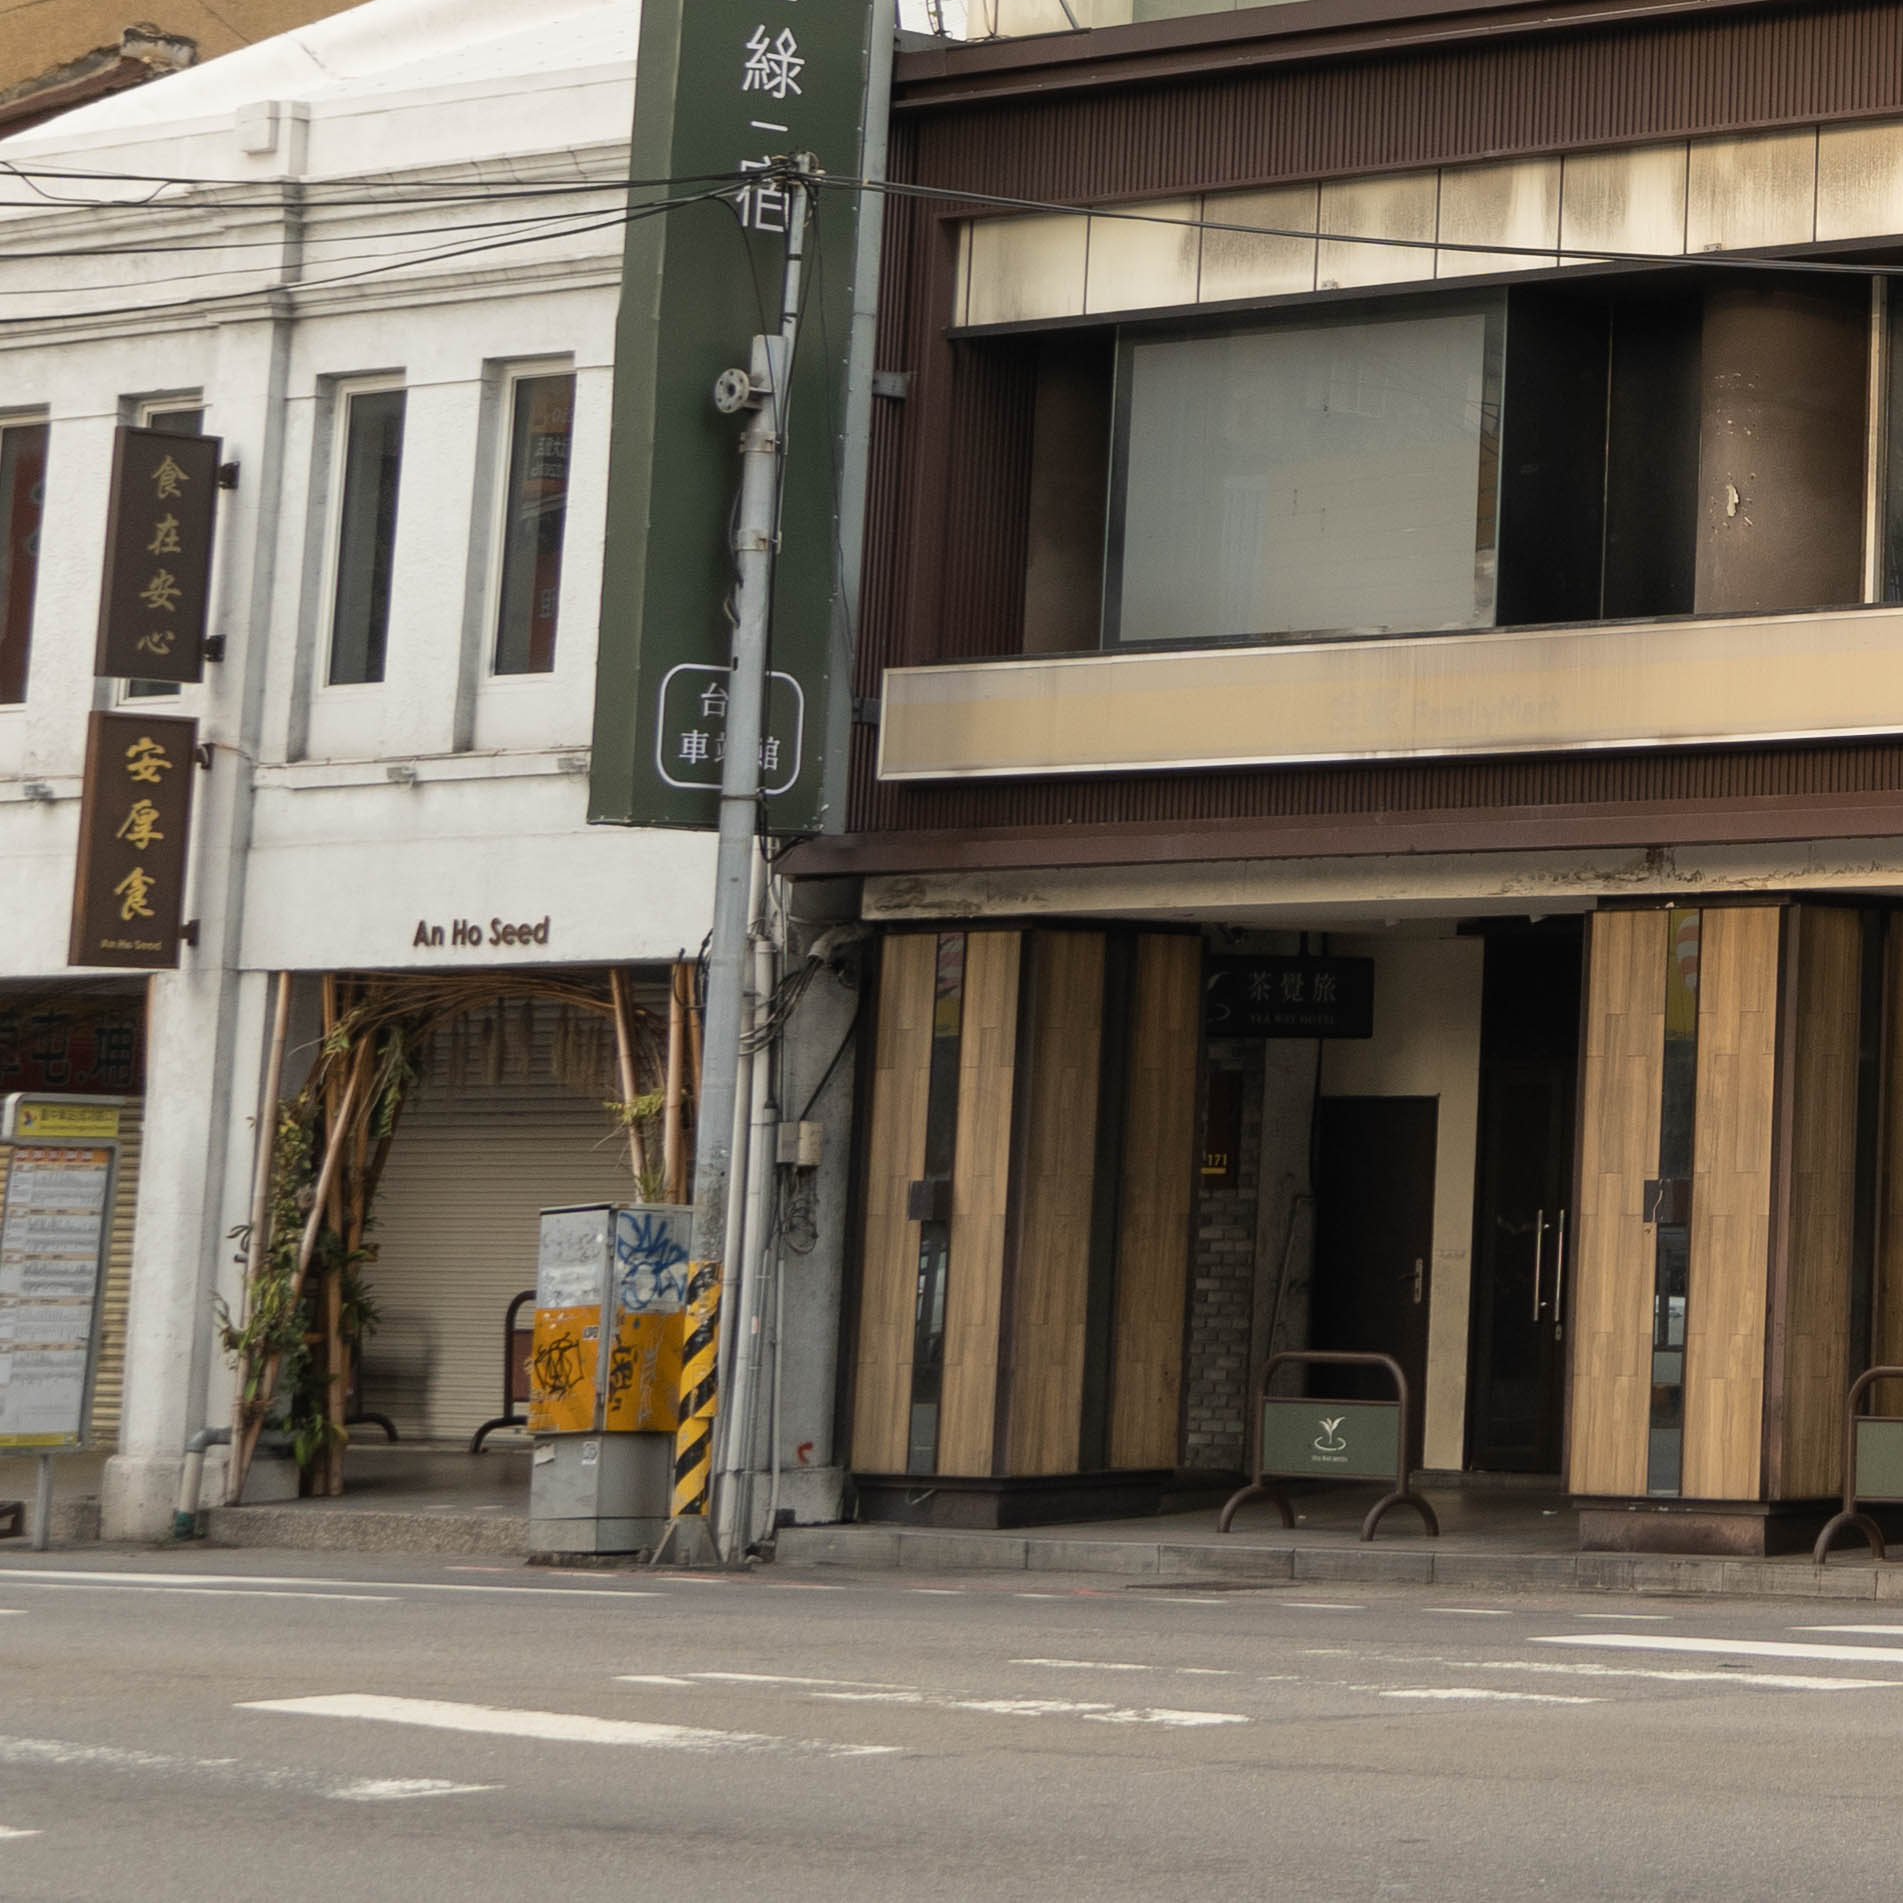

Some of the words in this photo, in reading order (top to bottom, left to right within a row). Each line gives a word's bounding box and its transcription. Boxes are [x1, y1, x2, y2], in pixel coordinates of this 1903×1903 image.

[138, 455, 190, 655] 食在安心
[413, 919, 443, 947] An
[451, 918, 482, 946] Ho
[489, 915, 550, 946] Seed
[1248, 971, 1337, 1003] 茶覺旅
